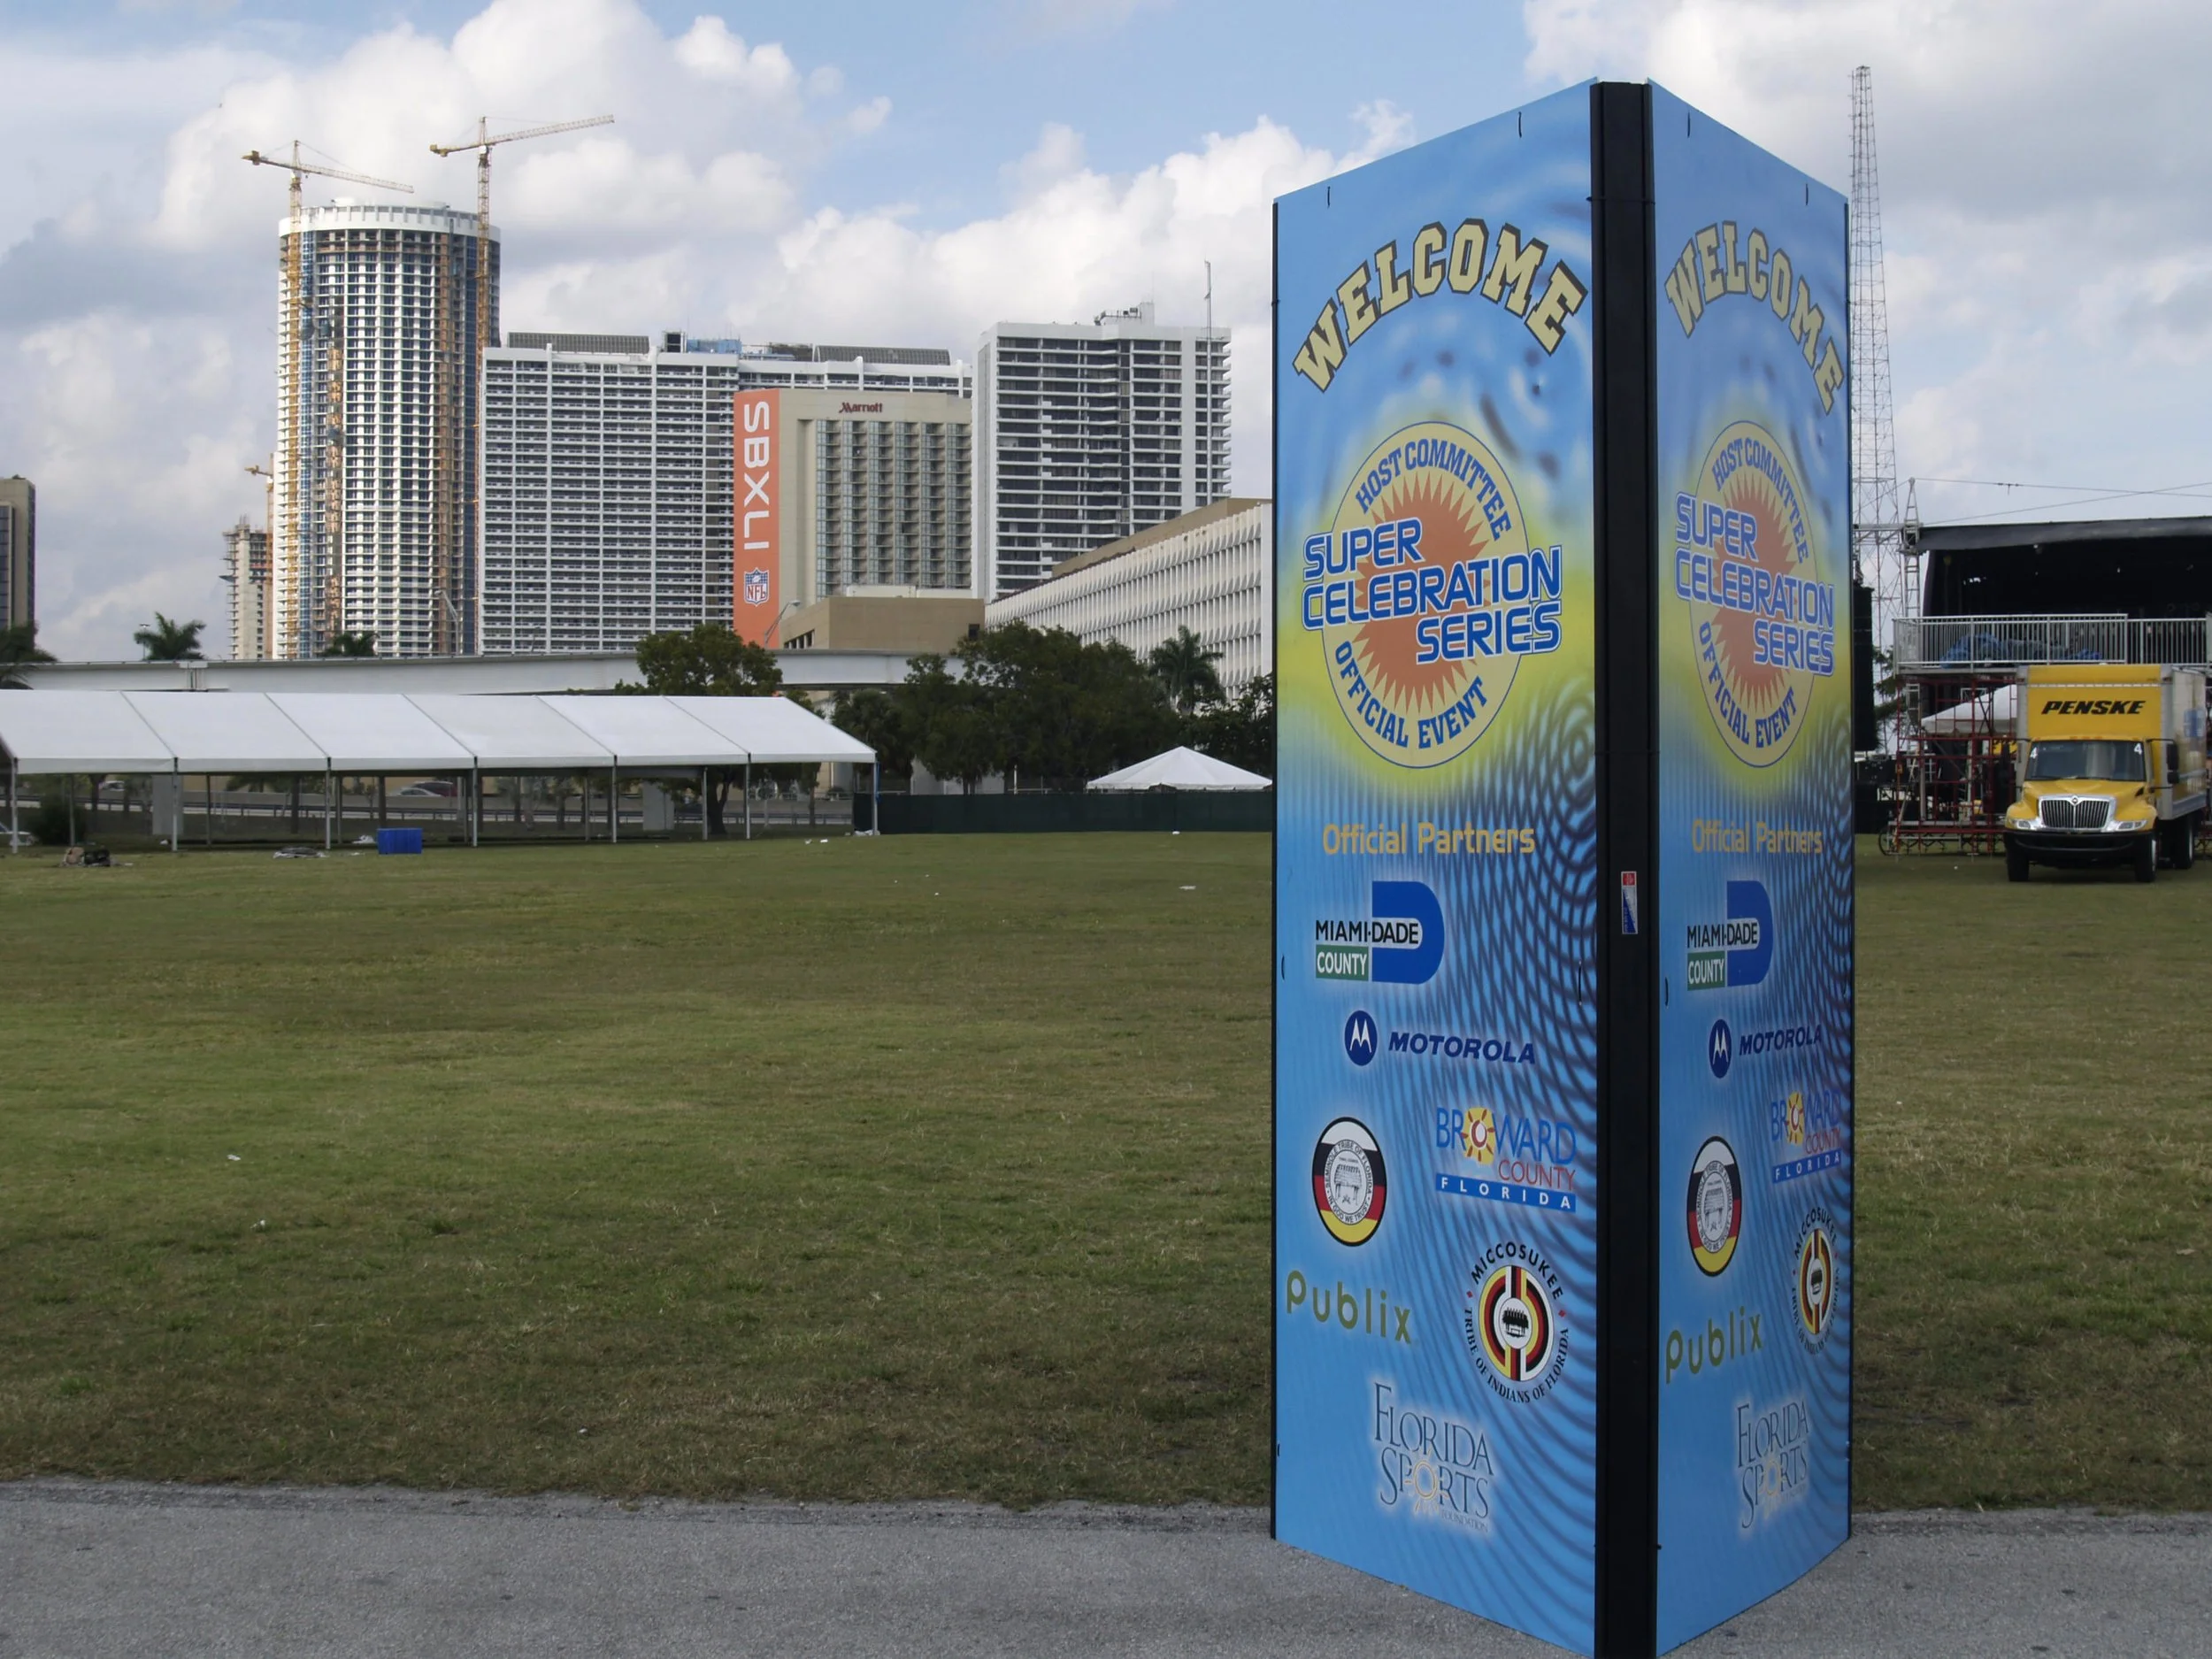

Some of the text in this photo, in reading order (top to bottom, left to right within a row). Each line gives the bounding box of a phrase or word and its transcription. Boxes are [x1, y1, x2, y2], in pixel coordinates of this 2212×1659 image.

[1292, 218, 1588, 393] WELCOME
[1664, 220, 1845, 416] WELCOME
[839, 402, 883, 413] Marriott
[743, 401, 770, 550] SBXLI
[1355, 438, 1512, 541] HOST COMMITTEE
[1712, 437, 1809, 564] HOST COMMITTEE
[1303, 517, 1425, 581] SUPER
[1675, 492, 1759, 563] SUPER
[748, 584, 767, 602] NFL
[1302, 545, 1563, 632] CELEBRATION
[1675, 546, 1835, 631] CELEBRATION
[1417, 598, 1563, 664] SERIES
[1753, 618, 1835, 678] SERIES
[1335, 640, 1488, 749] OFFICIAL EVENT
[1699, 620, 1798, 749] OFFICIAL EVENT
[2041, 700, 2147, 715] PENSKE
[1323, 821, 1536, 855] Official Partners
[1692, 818, 1823, 854] Official Partners
[1317, 951, 1368, 976] COUNTY
[1688, 958, 1724, 985] COUNTY
[1388, 1032, 1536, 1064] MOTOROLA
[1739, 1025, 1823, 1056] MOTOROLA
[1436, 1107, 1577, 1164] BROWARD
[1363, 1154, 1373, 1194] FLORIDA
[1441, 1177, 1571, 1210] FLORIDA
[1498, 1159, 1576, 1190] COUNTY
[1775, 1151, 1840, 1180] FLORIDA
[1794, 1206, 1837, 1260] MICCOSUKEE
[1471, 1240, 1563, 1301] MICCOSUKEE
[1464, 1307, 1569, 1404] TRIBE OF INDIANS OF FLORIDA
